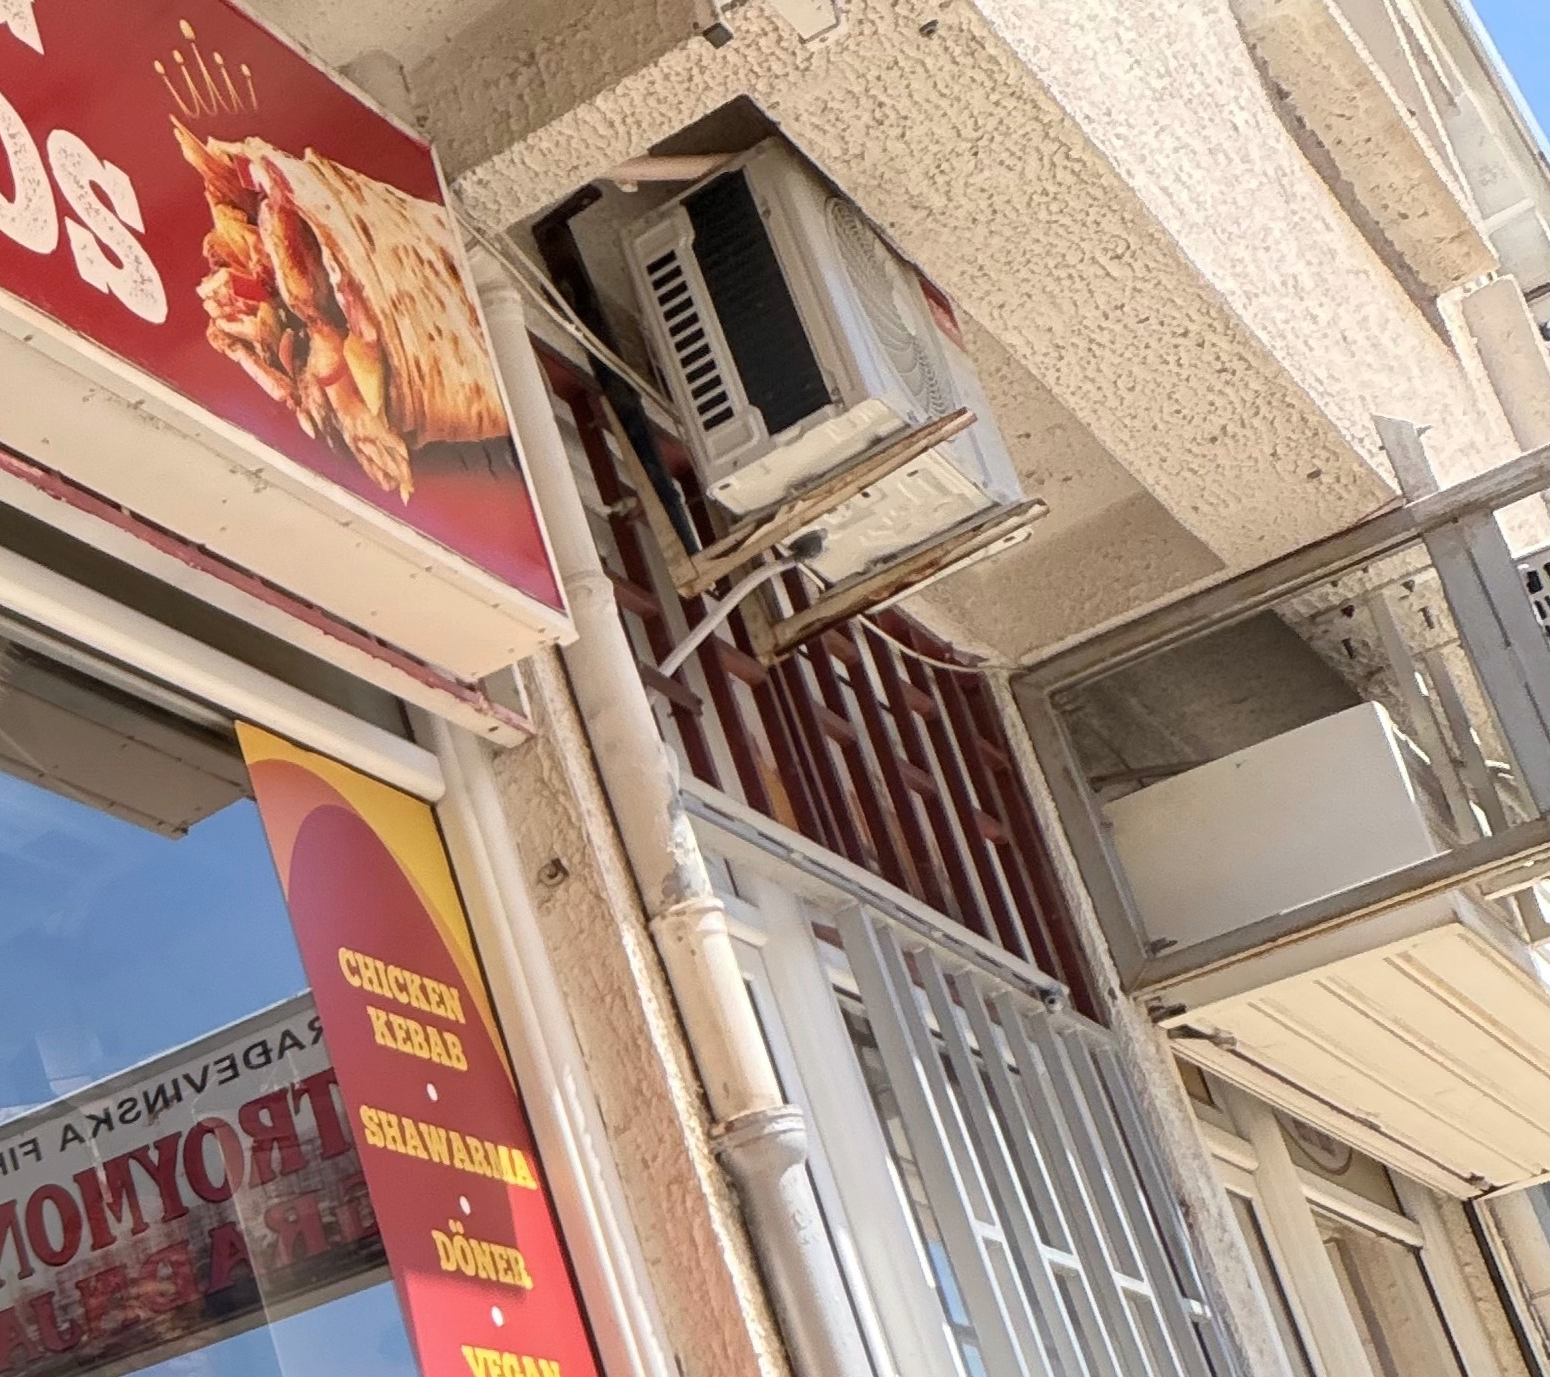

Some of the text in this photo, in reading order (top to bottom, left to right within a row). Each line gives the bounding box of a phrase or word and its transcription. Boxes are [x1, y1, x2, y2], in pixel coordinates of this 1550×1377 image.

[338, 947, 466, 1024] CHICKEN
[366, 1005, 468, 1071] KEBAB
[359, 1104, 538, 1190] SHAWARMA
[431, 1218, 534, 1290] DÖNER
